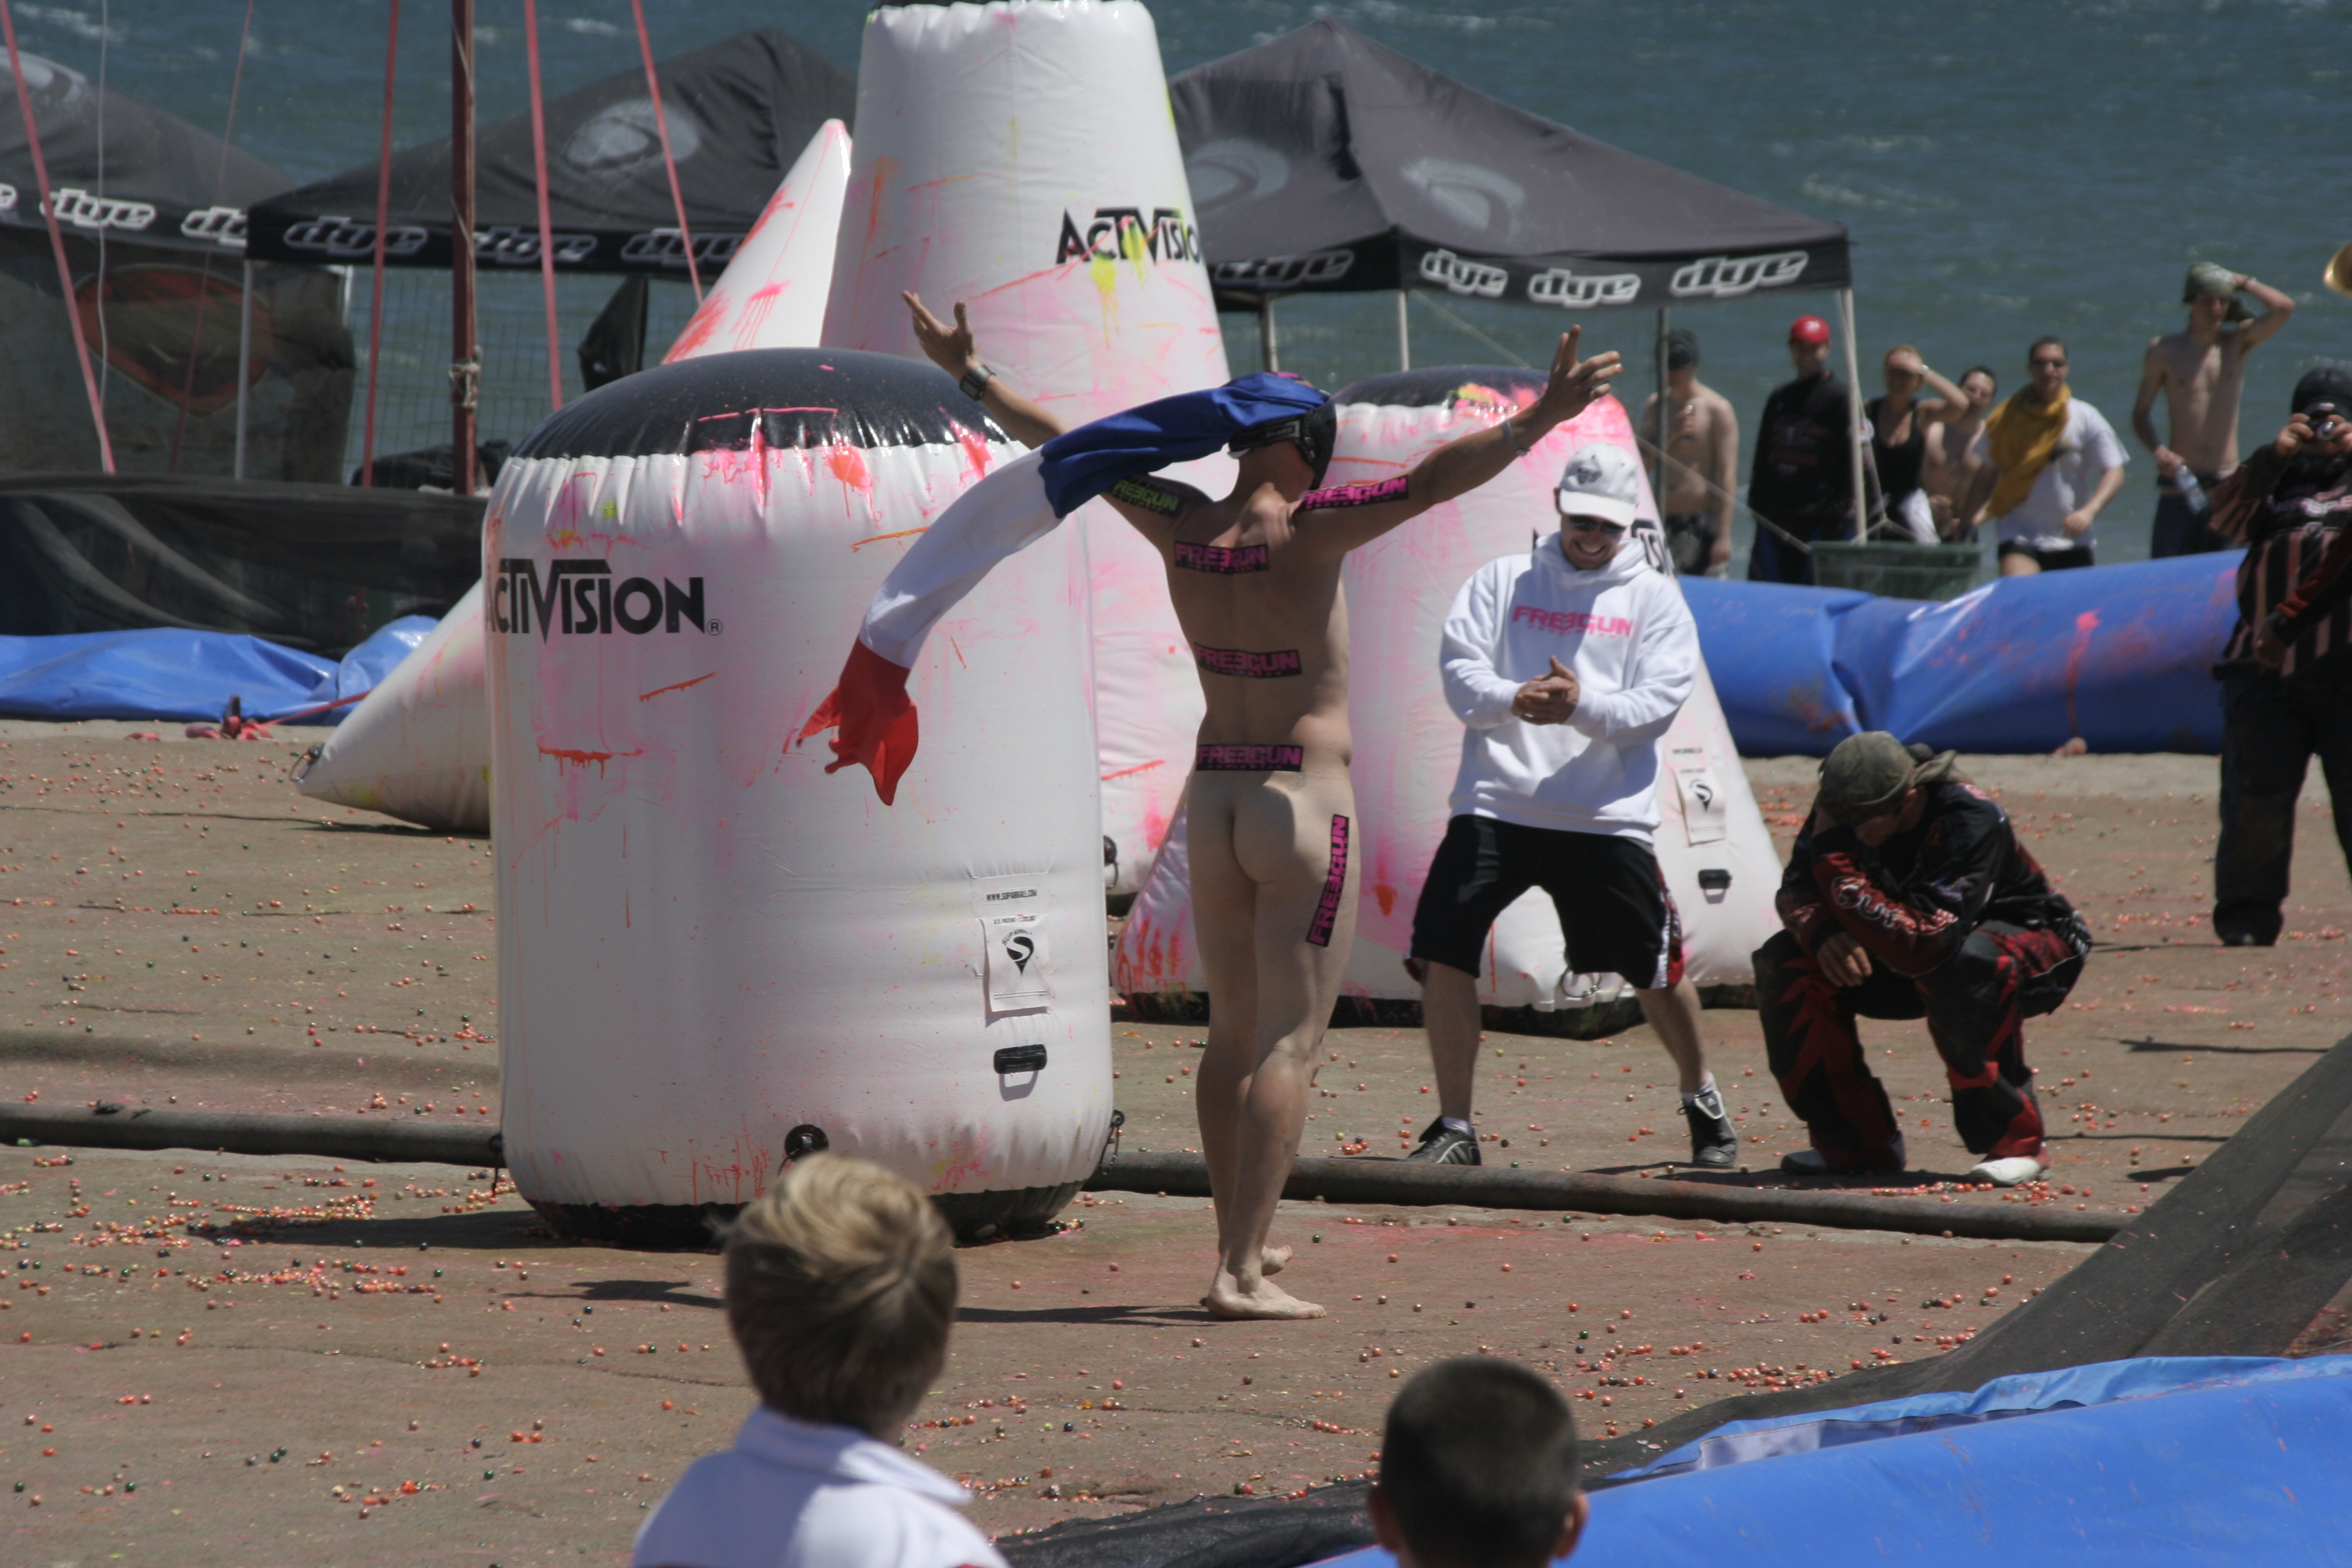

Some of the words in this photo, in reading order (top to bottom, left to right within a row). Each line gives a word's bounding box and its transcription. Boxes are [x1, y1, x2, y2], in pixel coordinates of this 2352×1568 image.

[1056, 206, 1200, 265] ACTIVISIO
[1197, 745, 1303, 769] FREEGUN
[1307, 815, 1348, 945] FREEGUN
